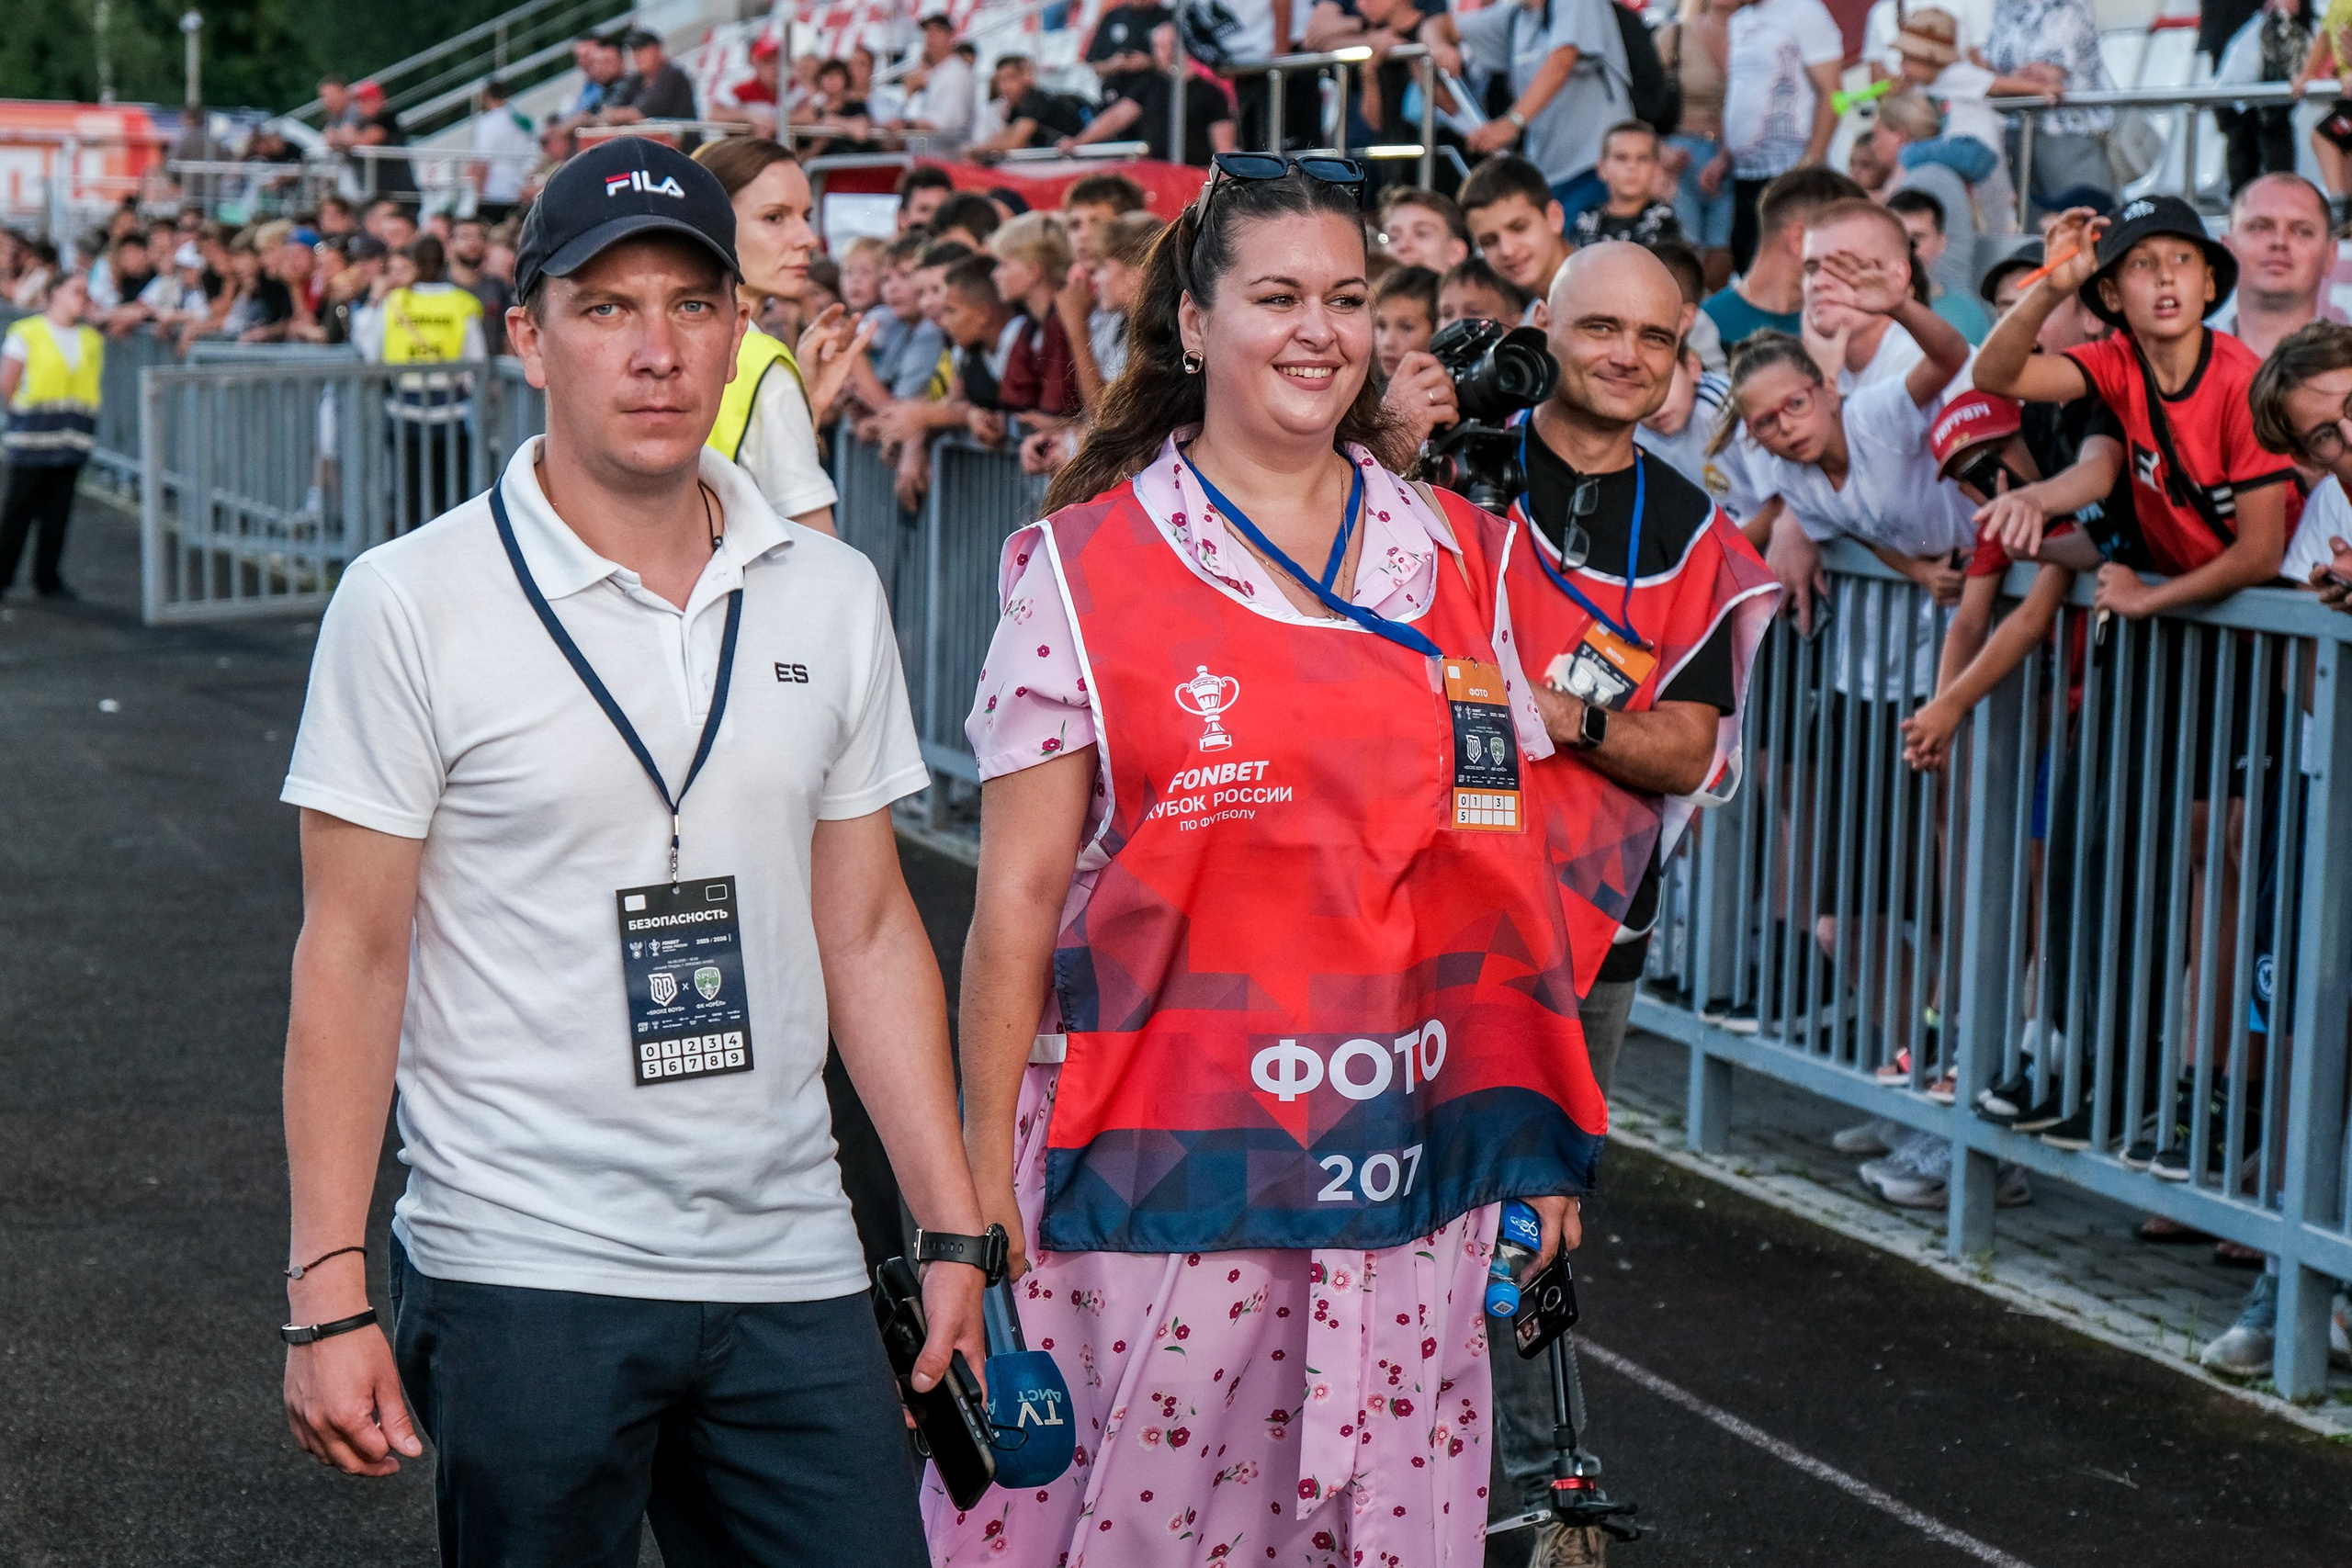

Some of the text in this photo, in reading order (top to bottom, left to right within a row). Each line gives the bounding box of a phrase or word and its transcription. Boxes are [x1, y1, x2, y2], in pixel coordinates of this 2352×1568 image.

[605, 170, 684, 198] FILA
[774, 661, 808, 683] ES
[1469, 688, 1488, 697] ФОТО
[1168, 761, 1270, 794] FONBET
[1214, 786, 1293, 807] РОССИИ
[1461, 795, 1501, 807] 0 1 3
[1180, 809, 1256, 831] ПО ФУТБОЛУ
[1461, 811, 1466, 821] 5
[628, 908, 729, 931] БЕЗОПАСНОСТЬ
[646, 1035, 738, 1057] 0 1 2 3 4
[648, 1053, 739, 1075] 5 6 7 8 9
[1250, 1019, 1447, 1102] ФОТО
[1317, 1144, 1423, 1202] 207
[1017, 1400, 1064, 1428] TV
